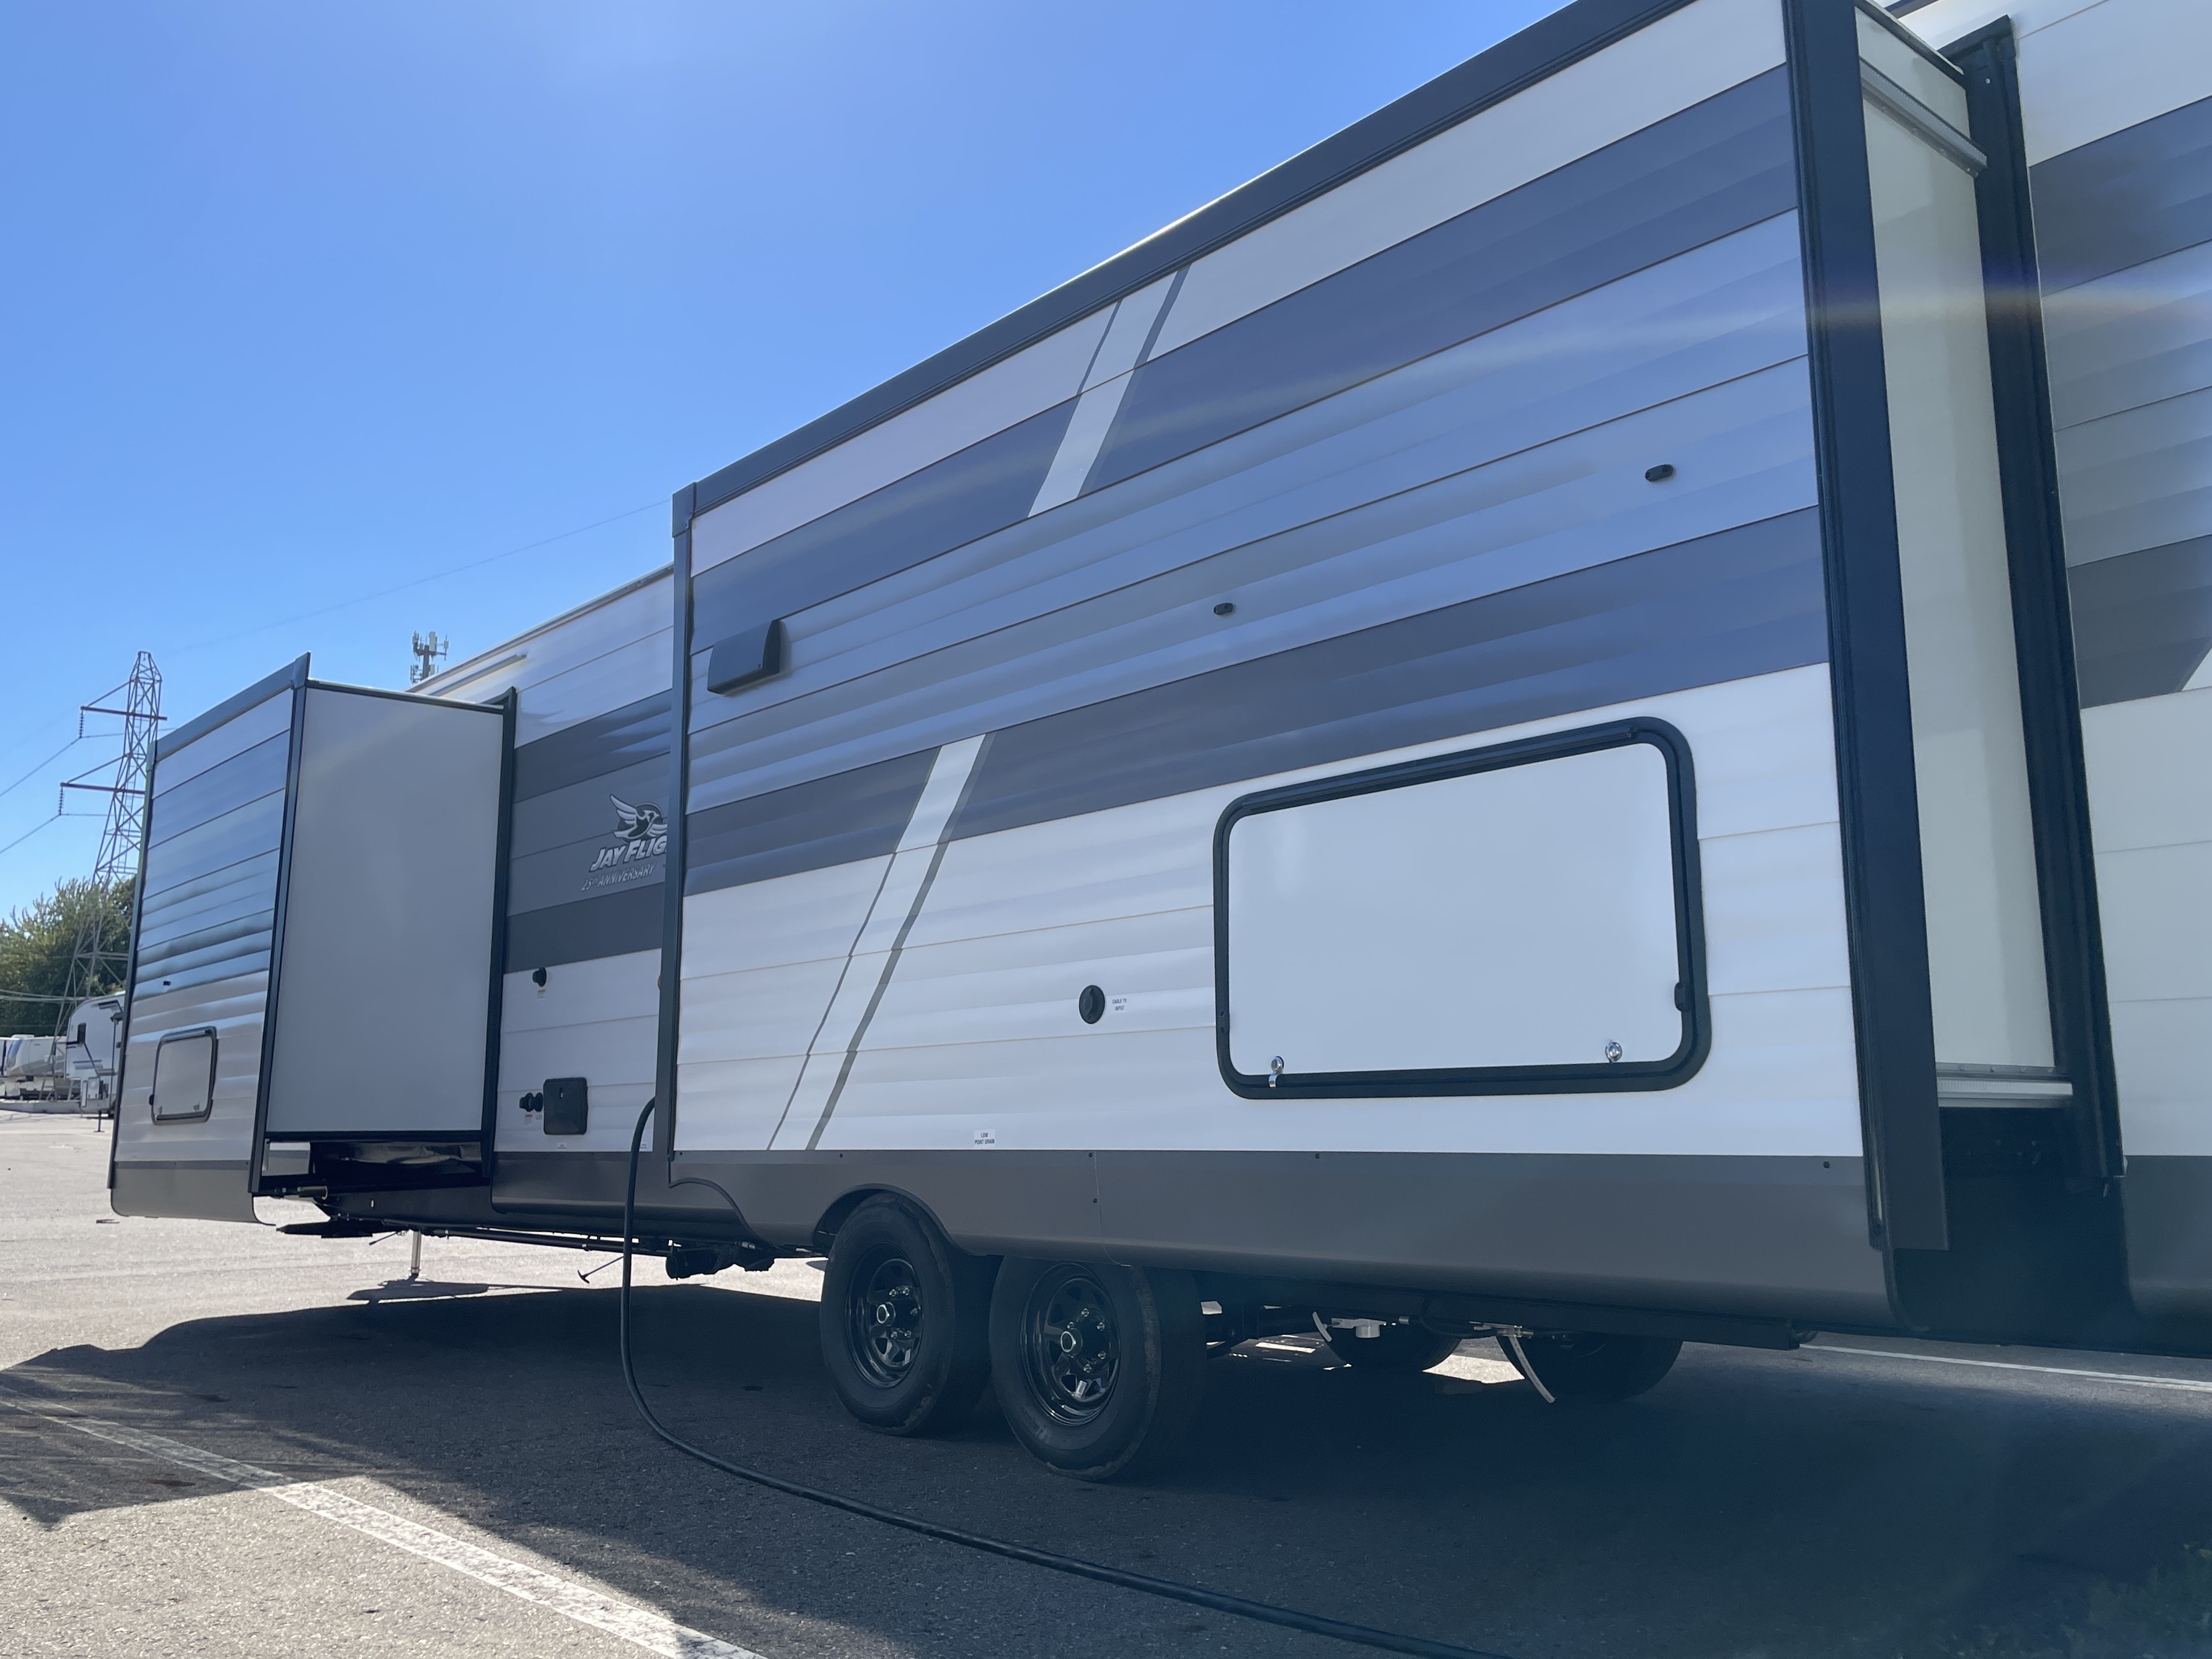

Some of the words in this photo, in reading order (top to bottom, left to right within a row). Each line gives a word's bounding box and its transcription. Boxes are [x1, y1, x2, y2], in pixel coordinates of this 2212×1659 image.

[590, 845, 626, 872] JAY
[624, 835, 667, 863] FLIG
[598, 863, 656, 888] ANNIVERSARY
